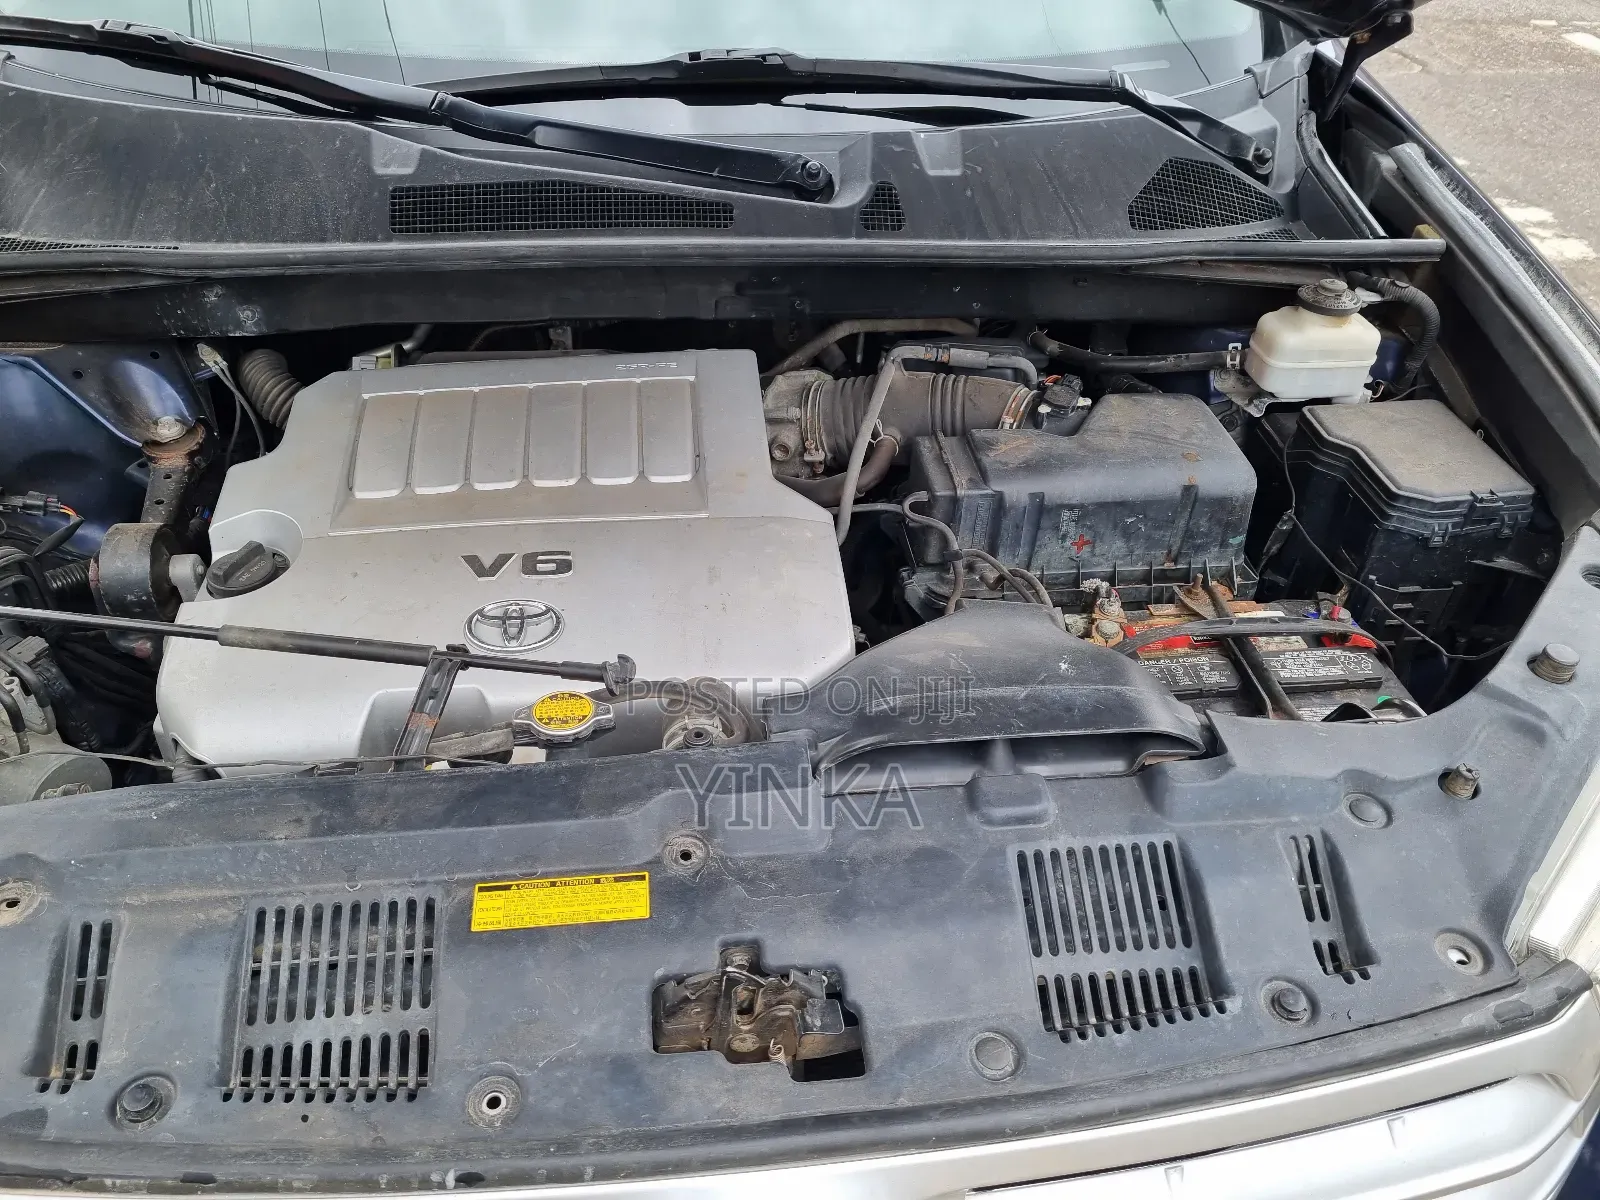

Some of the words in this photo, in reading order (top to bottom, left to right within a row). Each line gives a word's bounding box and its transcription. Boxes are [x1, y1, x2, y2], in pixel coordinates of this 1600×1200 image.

[459, 551, 573, 580] V6
[1178, 656, 1210, 664] POISON
[519, 881, 551, 890] CAUTION
[555, 878, 595, 887] ATTENTION
